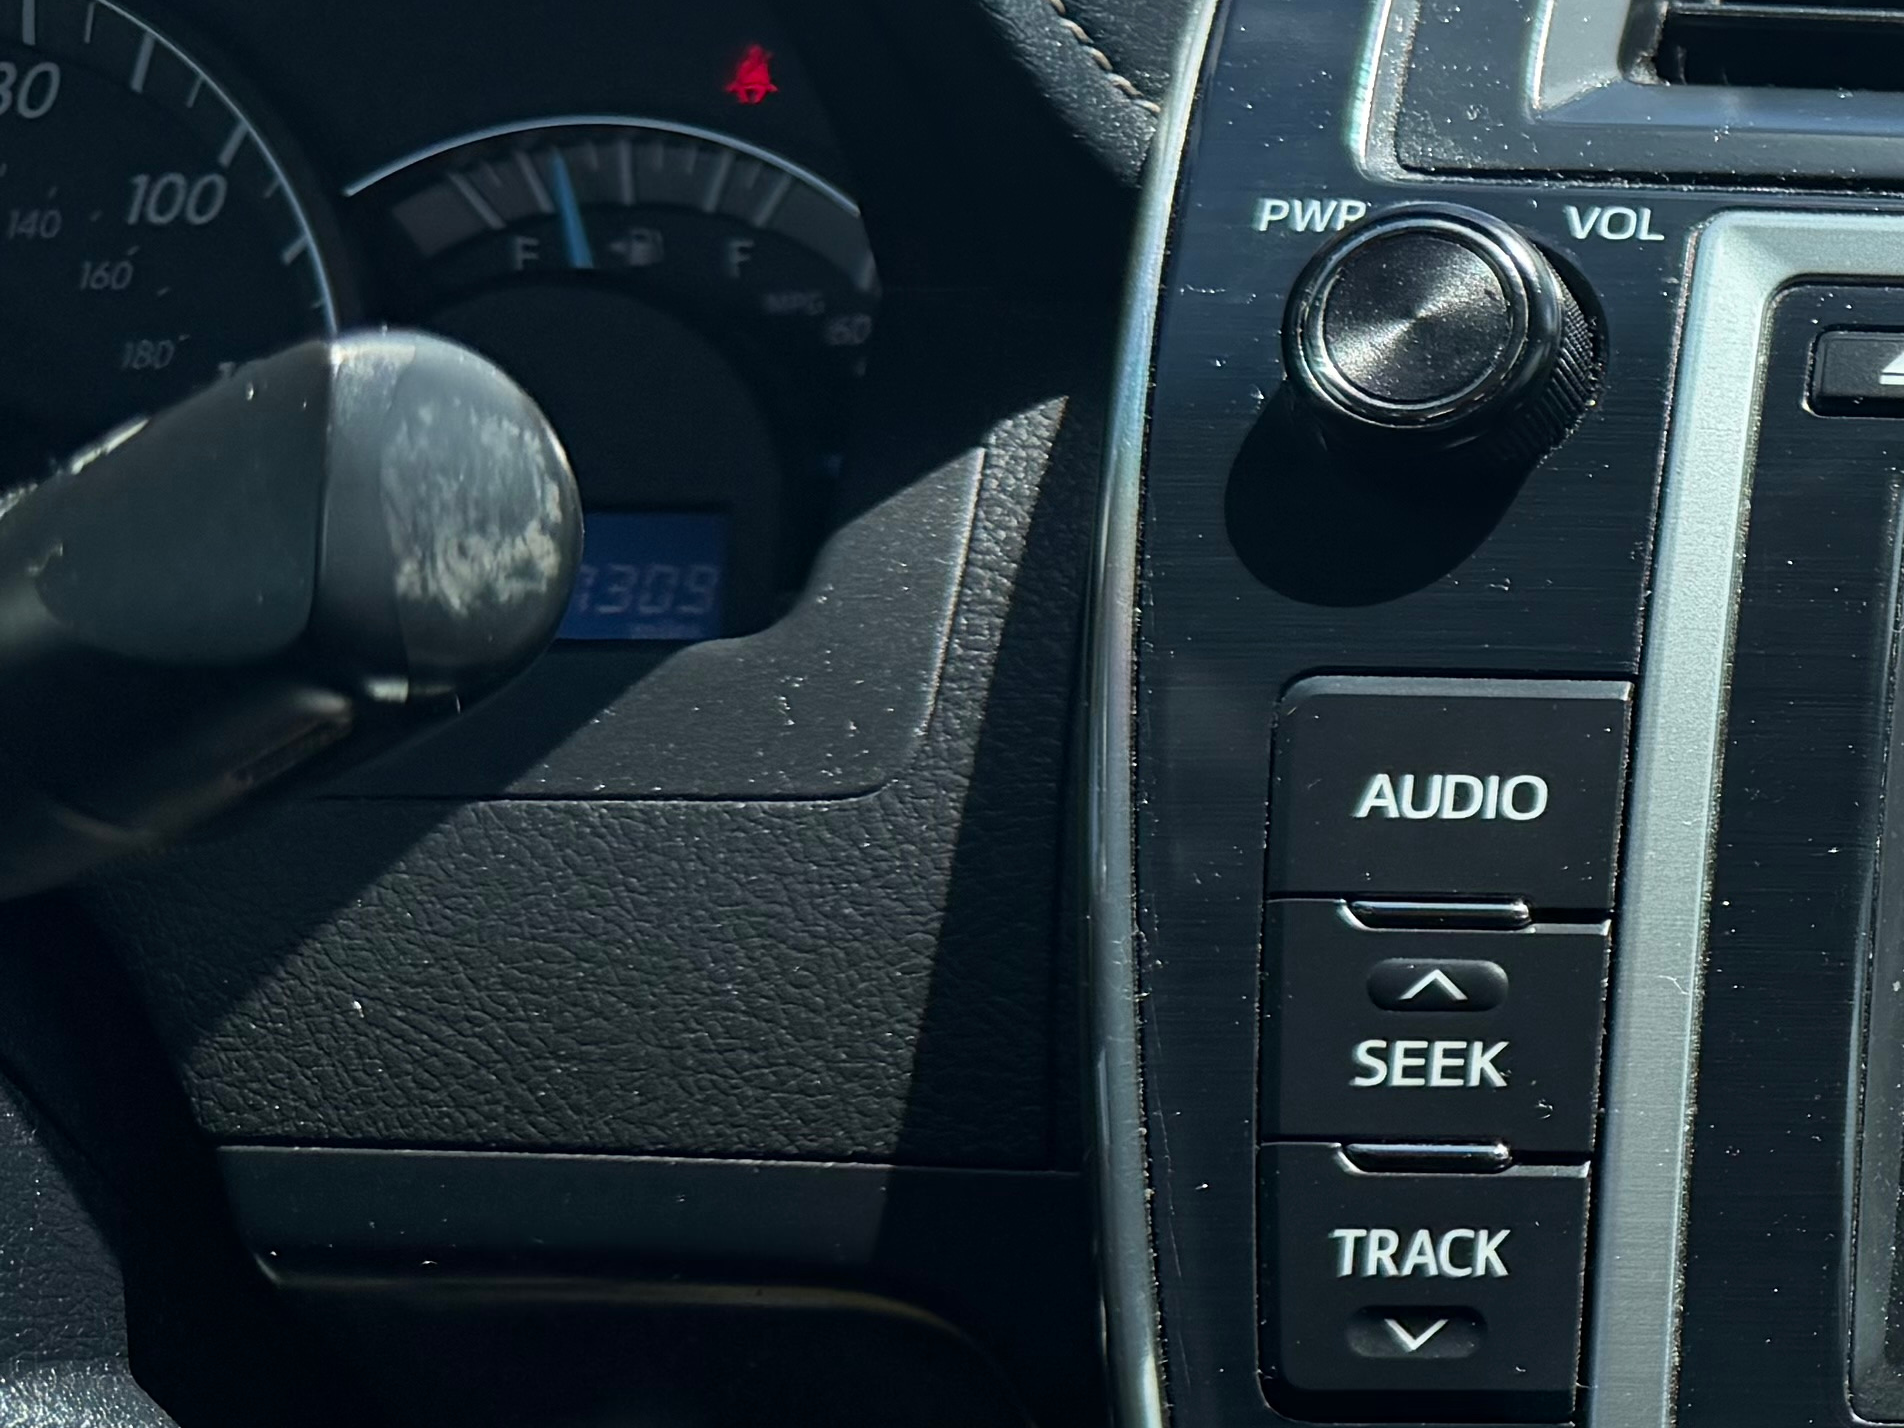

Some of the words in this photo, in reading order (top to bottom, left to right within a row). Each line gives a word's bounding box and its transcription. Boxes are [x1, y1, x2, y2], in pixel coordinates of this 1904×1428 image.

[126, 172, 228, 225] 100
[7, 209, 63, 240] 140
[1564, 204, 1666, 241] VOL
[80, 260, 134, 291] 160
[121, 339, 176, 370] 180
[1354, 773, 1549, 821] AUDIO
[1350, 1039, 1510, 1087] SEEK
[1332, 1228, 1511, 1278] TRACK
